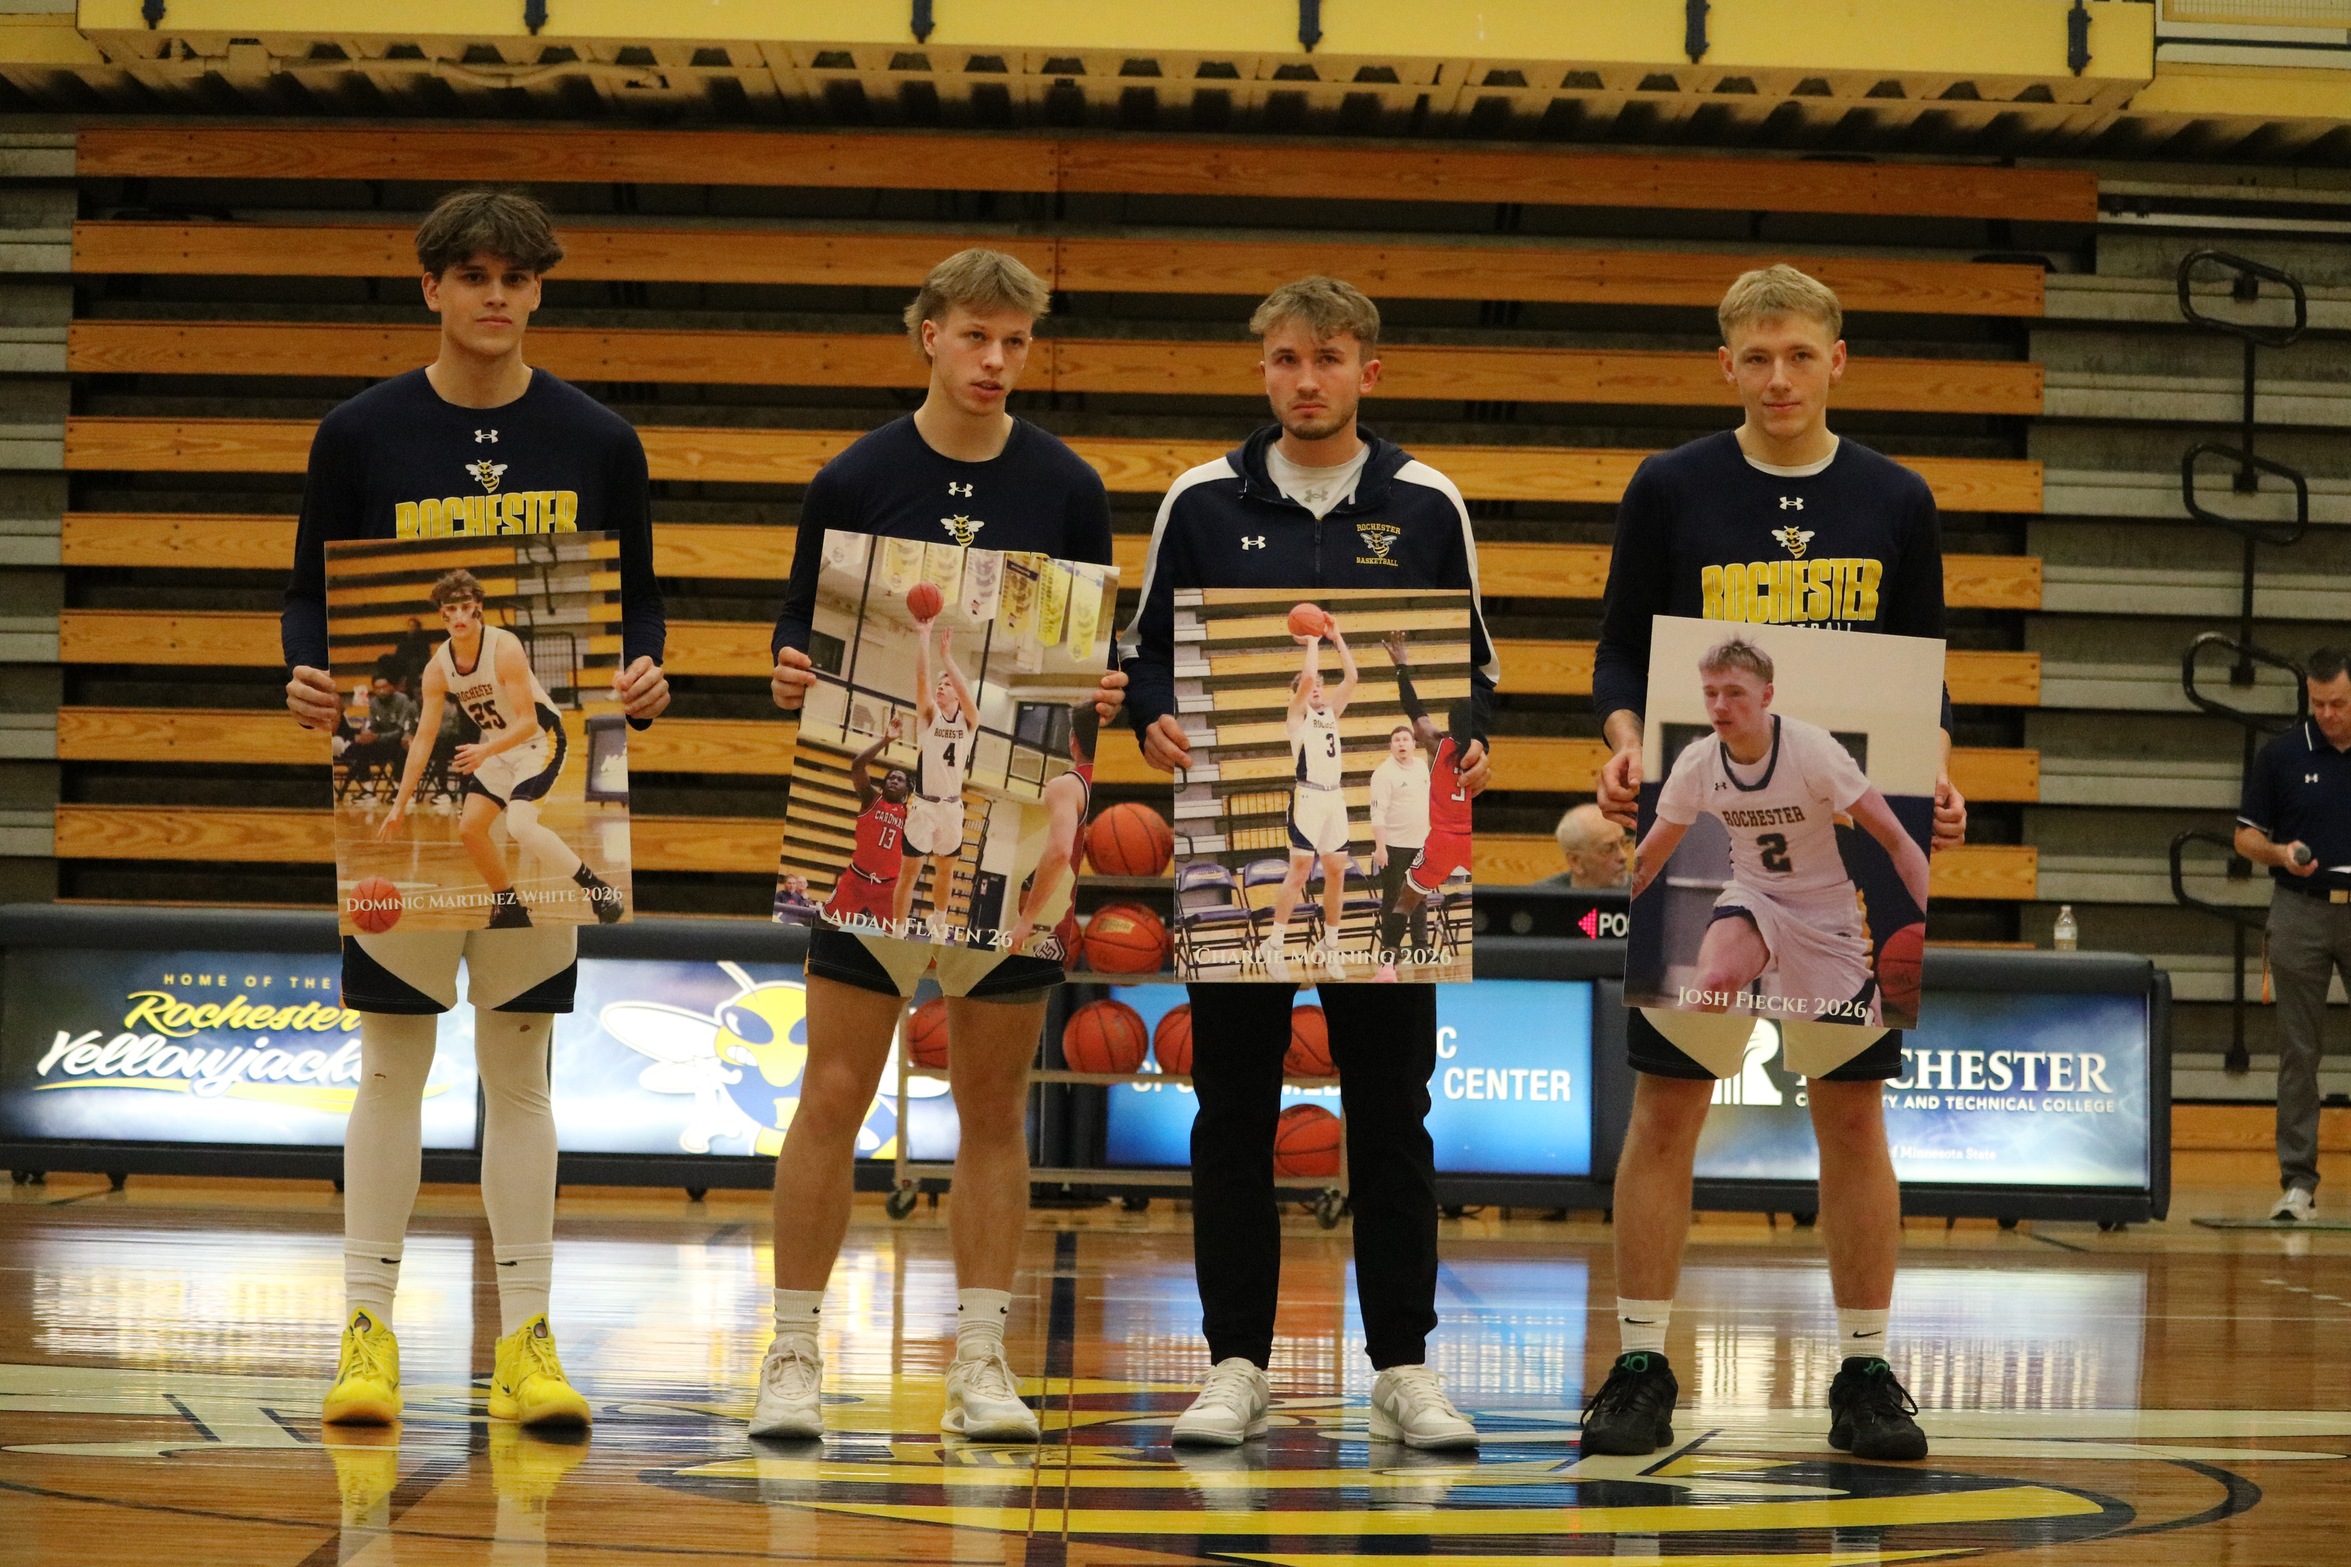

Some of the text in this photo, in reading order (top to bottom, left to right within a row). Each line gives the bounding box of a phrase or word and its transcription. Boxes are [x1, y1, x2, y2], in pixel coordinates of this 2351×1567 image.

[1356, 523, 1401, 535] ROCHESTER
[1356, 556, 1399, 567] BASKETBALL
[1701, 558, 1883, 624] ROCHESTER
[468, 699, 507, 730] 25
[934, 728, 963, 739] ROCHESTER
[1326, 733, 1336, 757] 3
[943, 742, 956, 767] 4
[1722, 805, 1805, 827] ROCHESTER
[878, 826, 897, 850] 13
[1756, 833, 1793, 873] 2
[345, 885, 623, 913] DOMINIC MARTINEZ-WHITE 2026
[827, 908, 1013, 948] AIDAN FLATEN 26
[1599, 912, 1629, 937] PO
[1195, 948, 1452, 966] CHARLIE MORNING 2026
[163, 974, 331, 989] HOME OF THE
[124, 990, 361, 1037] Rochester
[1677, 986, 1867, 1018] JOSH FIECKE 2026
[1884, 1048, 2114, 1094] CHESTER
[1443, 1066, 1571, 1102] CENTER
[1903, 1094, 1941, 1110] AND
[1944, 1095, 2037, 1112] TECHNICAL
[2041, 1097, 2116, 1114] COLLEGE
[1900, 1144, 1964, 1160] Minnesota
[1965, 1146, 1997, 1161] State
